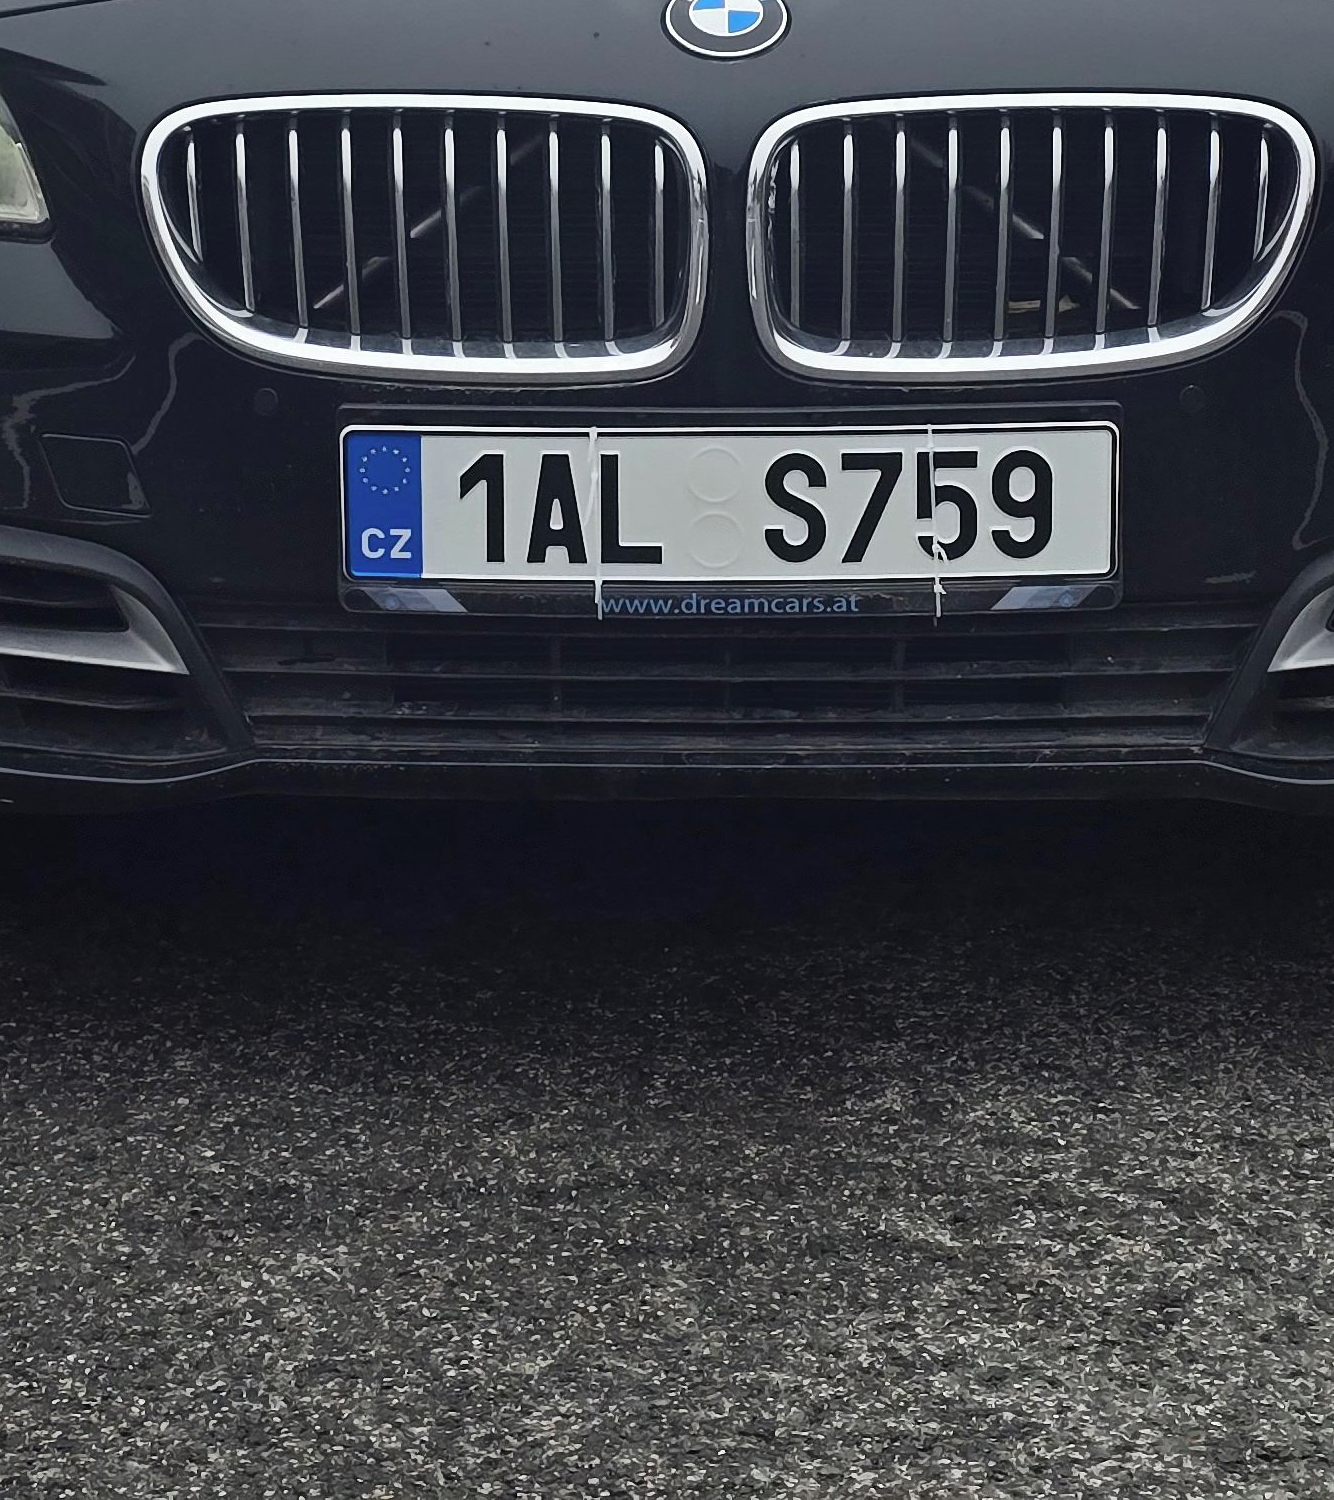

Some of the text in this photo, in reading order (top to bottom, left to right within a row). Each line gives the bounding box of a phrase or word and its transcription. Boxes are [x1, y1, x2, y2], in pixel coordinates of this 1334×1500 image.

[459, 449, 1053, 564] 1AL S759
[361, 527, 412, 559] CZ
[601, 592, 860, 614] www.dreamcars.at
